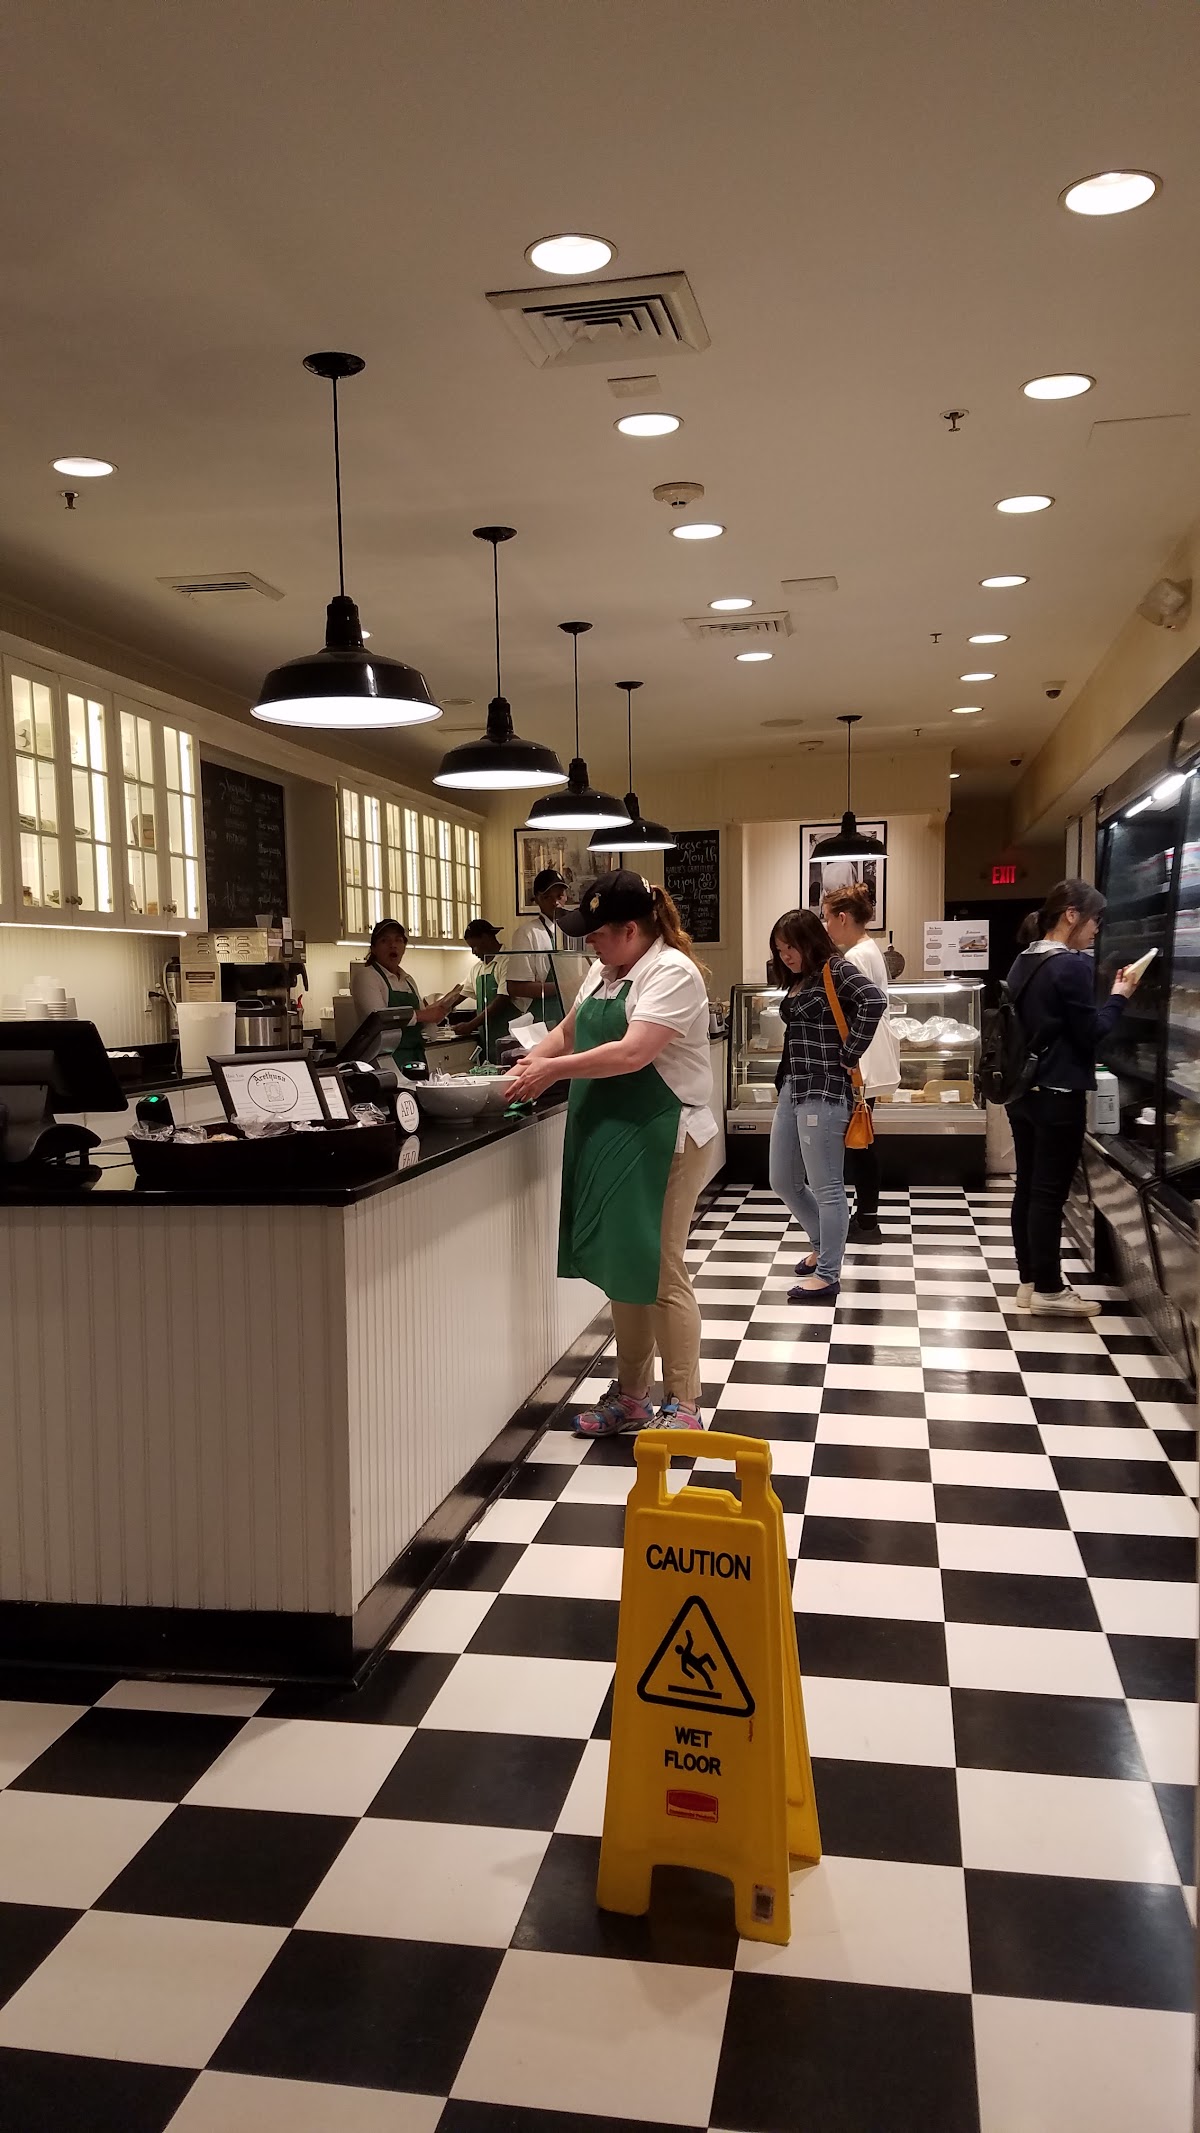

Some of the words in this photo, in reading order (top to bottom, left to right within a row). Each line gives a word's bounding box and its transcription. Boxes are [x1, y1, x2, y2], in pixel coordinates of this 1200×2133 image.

[671, 834, 701, 852] heese
[680, 846, 718, 865] Month
[667, 874, 696, 893] Enjoy
[992, 866, 1016, 884] EXIT
[253, 1072, 286, 1084] Arethusa
[646, 1544, 751, 1581] CAUTION
[675, 1726, 712, 1748] WET
[665, 1750, 721, 1776] FLOOR
